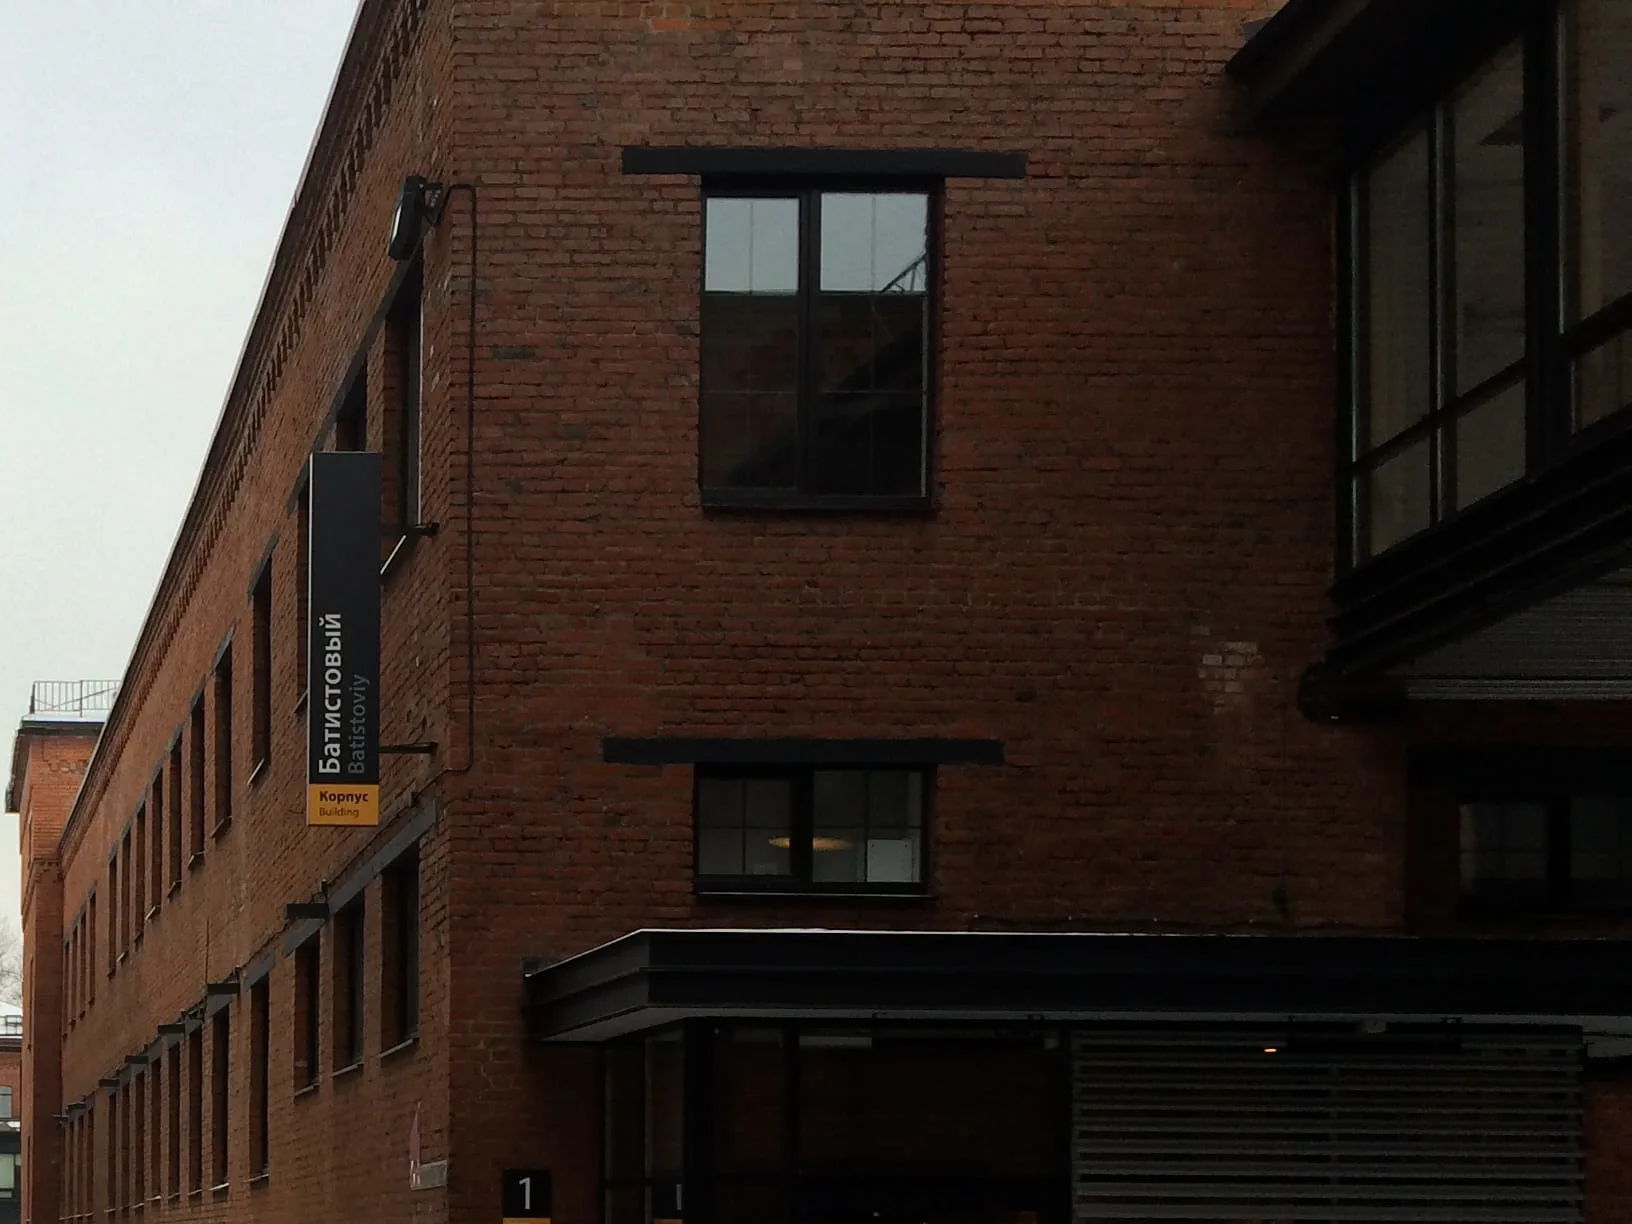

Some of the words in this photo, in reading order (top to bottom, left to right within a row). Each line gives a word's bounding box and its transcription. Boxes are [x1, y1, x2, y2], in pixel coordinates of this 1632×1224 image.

[318, 612, 342, 775] Батистовый
[348, 673, 371, 775] Batistoviy
[319, 790, 369, 804] Корпус
[319, 806, 360, 818] Building
[519, 1176, 531, 1210] 1
